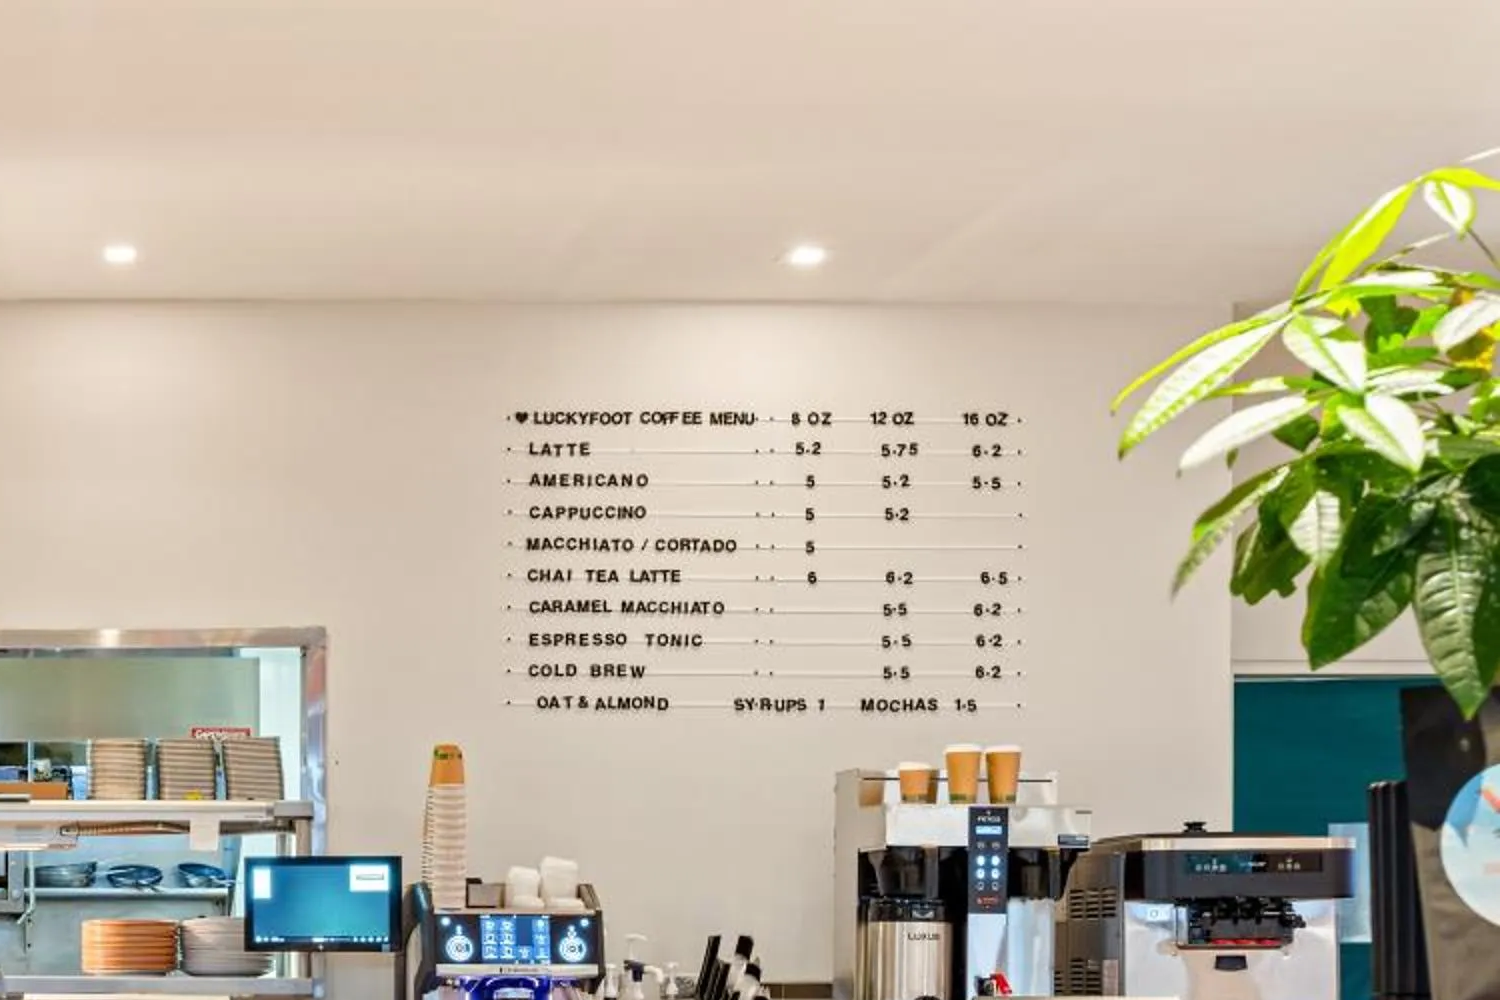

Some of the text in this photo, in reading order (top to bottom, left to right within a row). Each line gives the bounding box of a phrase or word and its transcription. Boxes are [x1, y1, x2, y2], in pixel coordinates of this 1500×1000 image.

[533, 410, 1009, 428] LUCKYFOOT COFFEE MENU 8 OZ 12 OZ 16 OZ
[528, 441, 591, 458] LATTE
[528, 472, 649, 489] AMERICANO
[804, 474, 816, 490] 5
[528, 505, 647, 521] CAPPUCCINO
[804, 507, 815, 522] 5
[525, 536, 816, 556] MACCHIATO / CORTADO 5
[526, 568, 573, 583] CHAI
[584, 568, 620, 584] TEA
[629, 568, 682, 584] LATTE
[806, 570, 818, 586] 6
[528, 599, 613, 615] CARAMEL
[619, 599, 725, 616] MACCHIATO
[528, 632, 628, 648] ESPRESSO
[644, 633, 703, 648] TONIC
[527, 663, 578, 678] COLD
[589, 663, 646, 679] BREW
[536, 695, 574, 710] OAT
[577, 695, 590, 709] &
[594, 695, 670, 712] ALMOND
[817, 698, 825, 712] 1
[859, 697, 939, 713] MOCHAS
